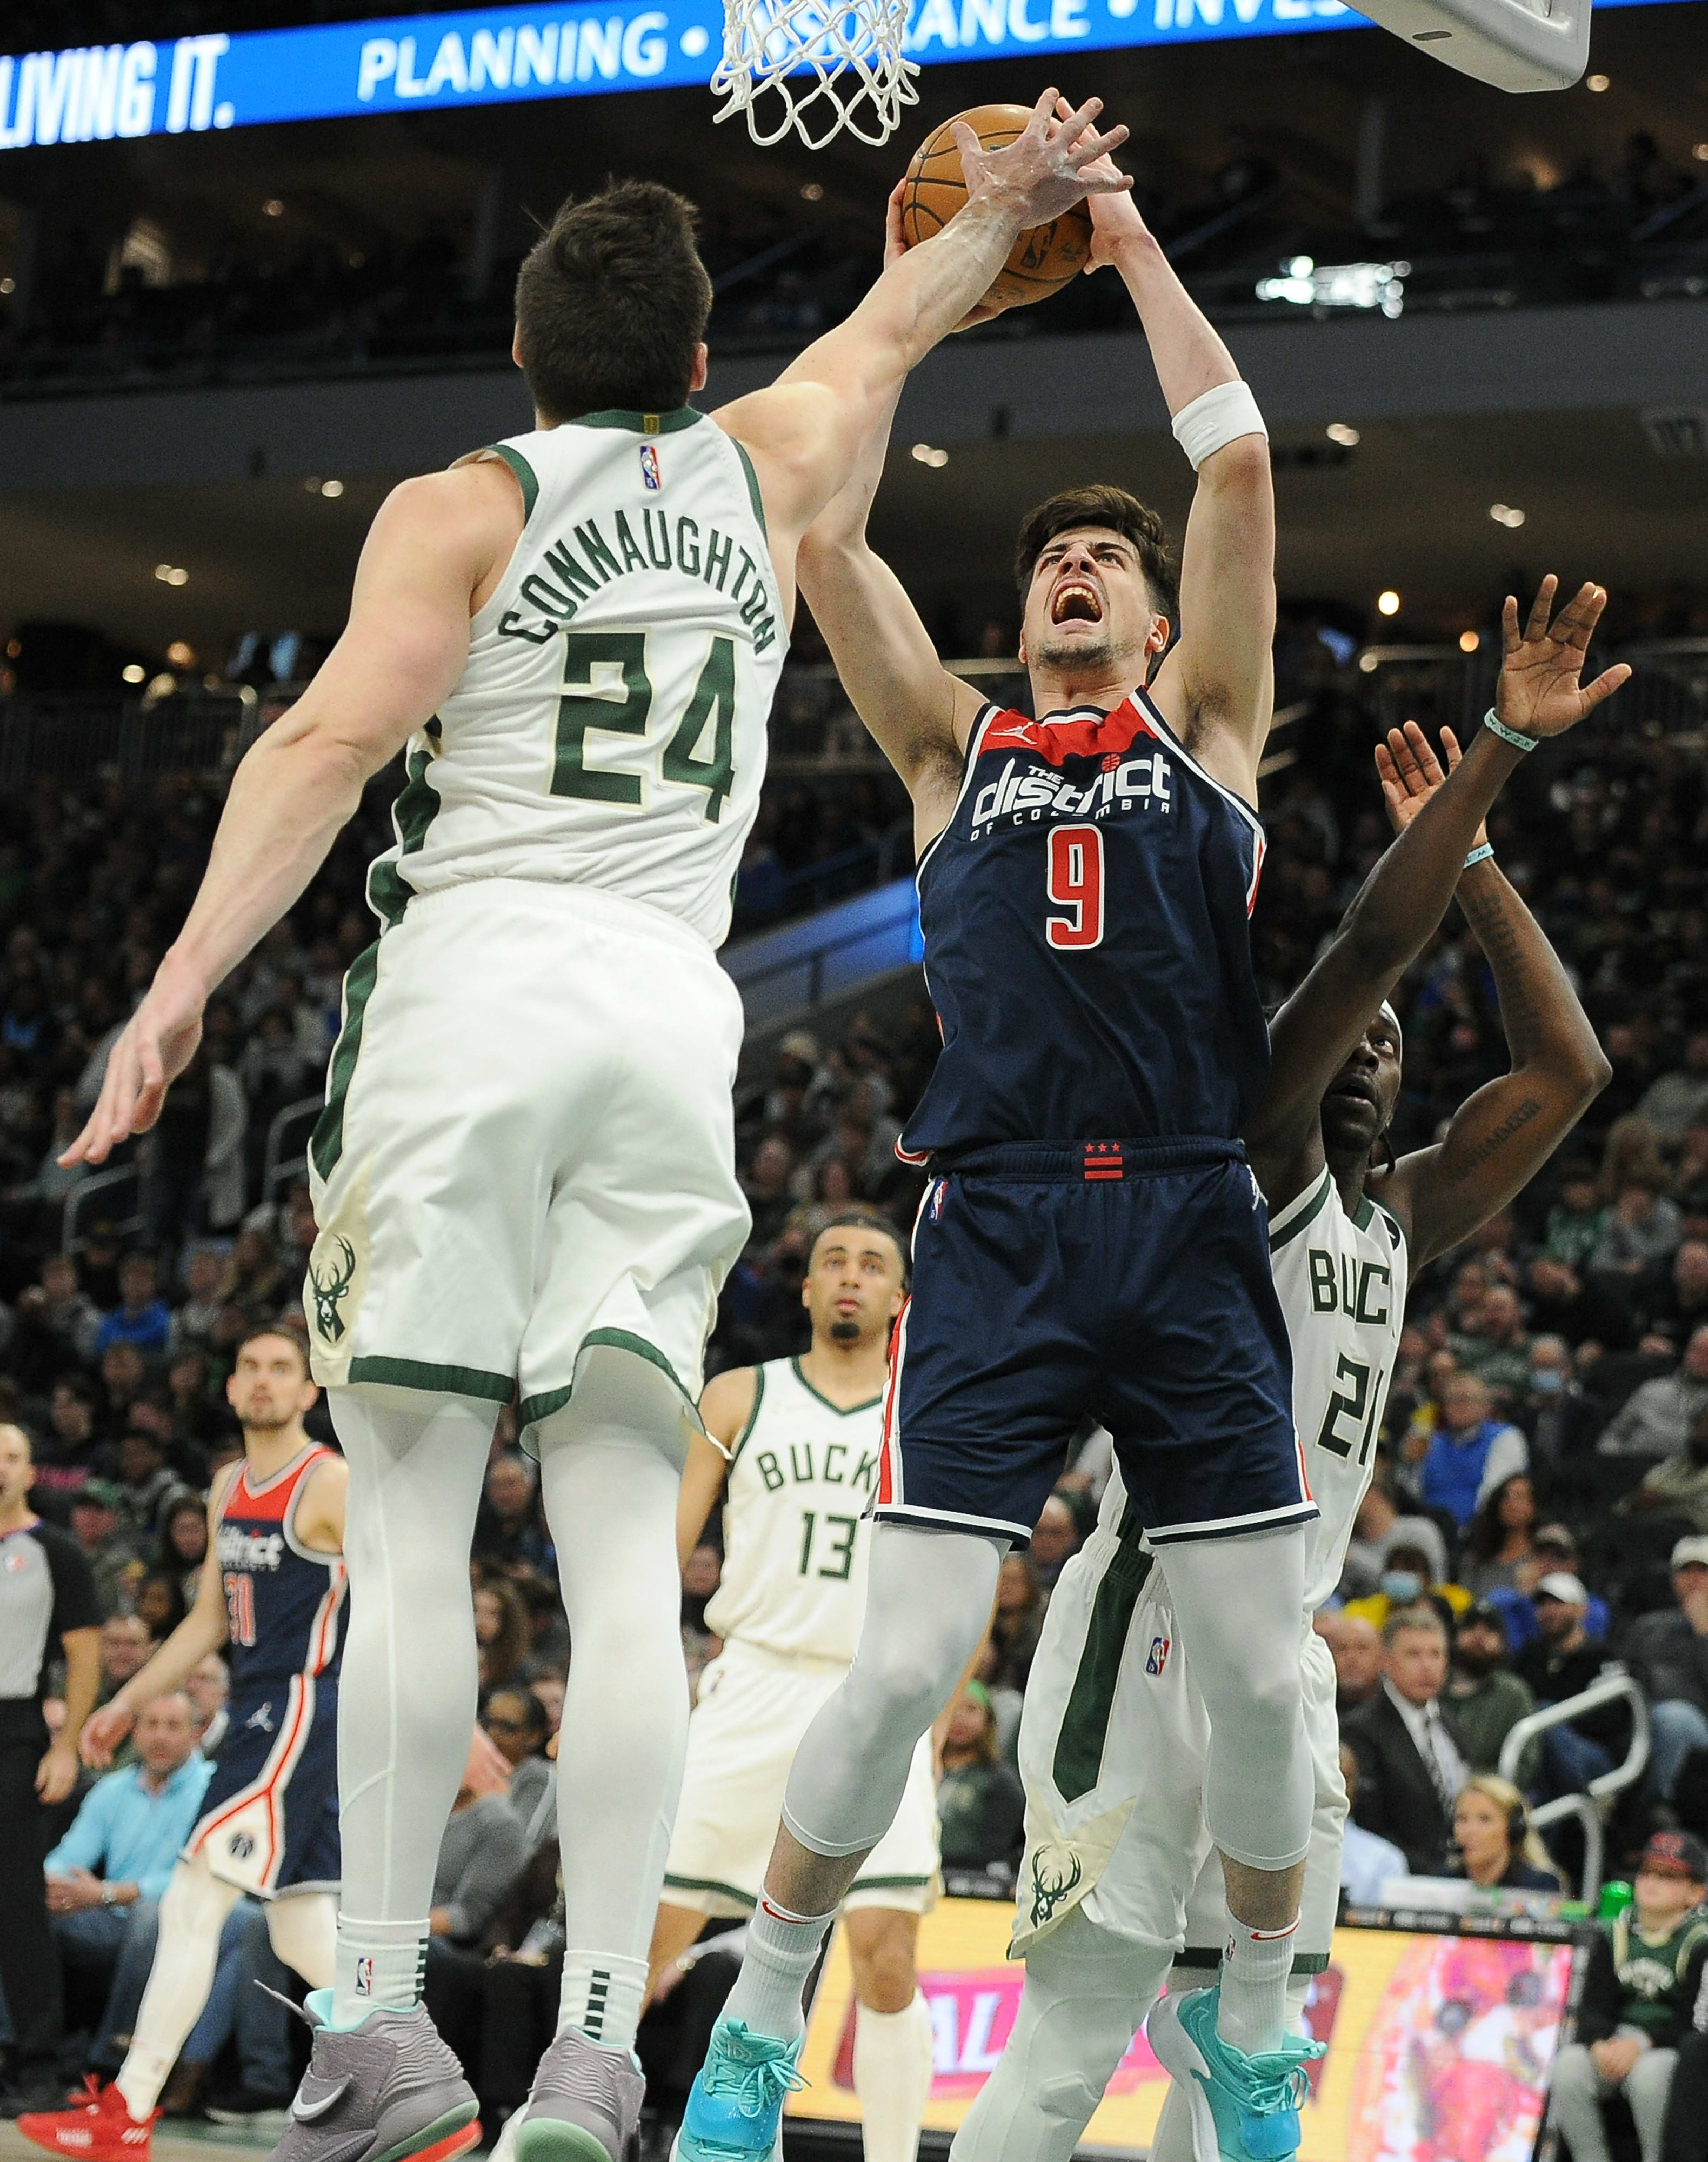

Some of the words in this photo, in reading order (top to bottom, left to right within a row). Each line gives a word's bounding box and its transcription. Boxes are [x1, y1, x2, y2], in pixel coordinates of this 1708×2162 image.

[0, 40, 158, 149] LIVING
[166, 32, 236, 134] IT.
[357, 11, 668, 102] PLANNING
[725, 0, 1091, 62] NSURANCE
[498, 508, 776, 656] CONNAUGHTON
[547, 627, 738, 827] 24
[1028, 765, 1065, 785] THE
[970, 822, 994, 842] OF
[1012, 798, 1171, 826] COMBIA
[972, 752, 1171, 827] district
[1046, 824, 1105, 950] 9
[1315, 1351, 1385, 1466] 21
[758, 1443, 878, 1492] BUCK
[800, 1512, 858, 1581] 13
